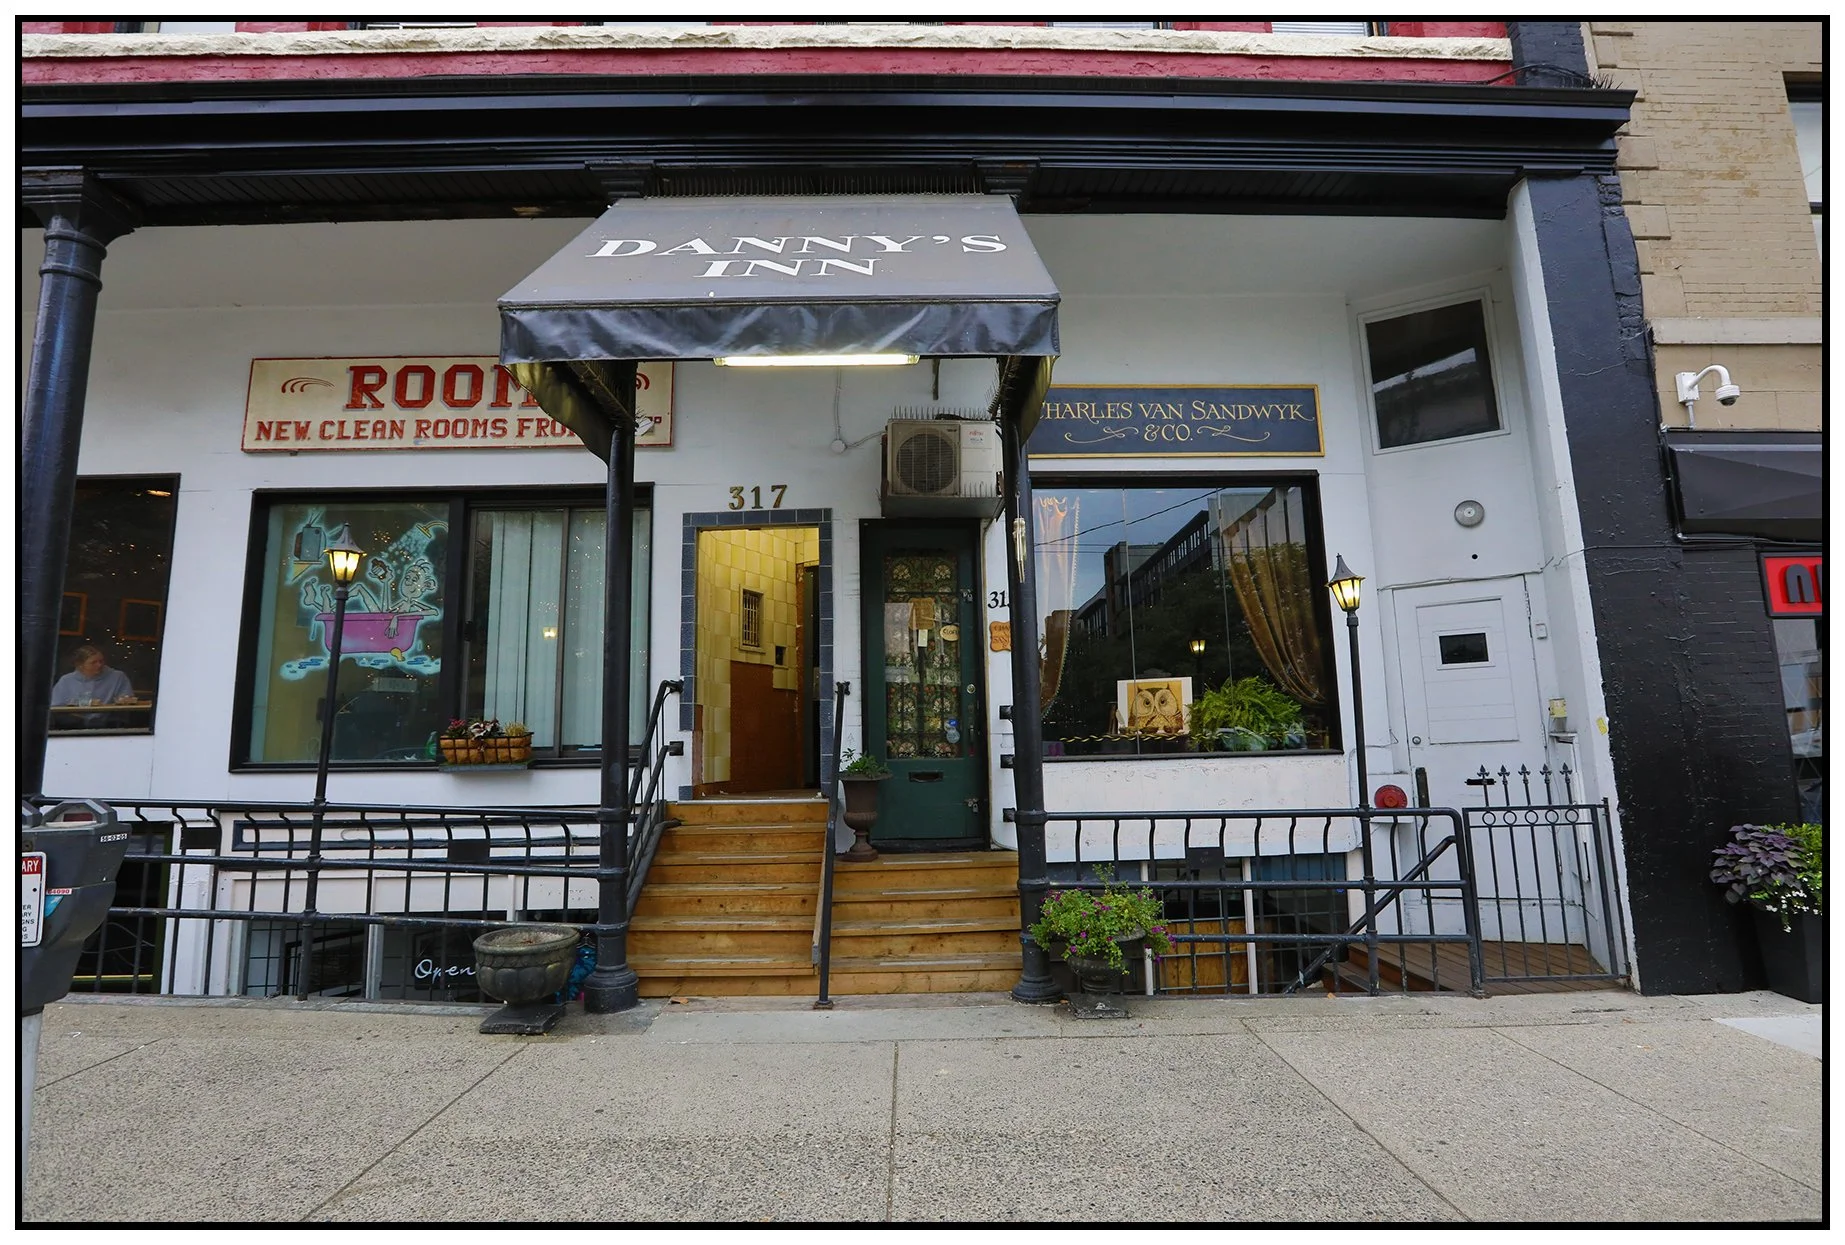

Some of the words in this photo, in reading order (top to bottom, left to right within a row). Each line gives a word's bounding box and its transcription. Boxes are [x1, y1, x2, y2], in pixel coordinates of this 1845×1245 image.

[585, 235, 1007, 258] DANNY'S
[693, 258, 882, 278] INN
[1138, 402, 1184, 420] VAN
[318, 419, 406, 440] CLEAN
[414, 418, 508, 439] ROOMS
[515, 417, 575, 438] FRO
[728, 484, 788, 510] 317
[987, 590, 1010, 609] 31
[414, 958, 476, 984] Open
